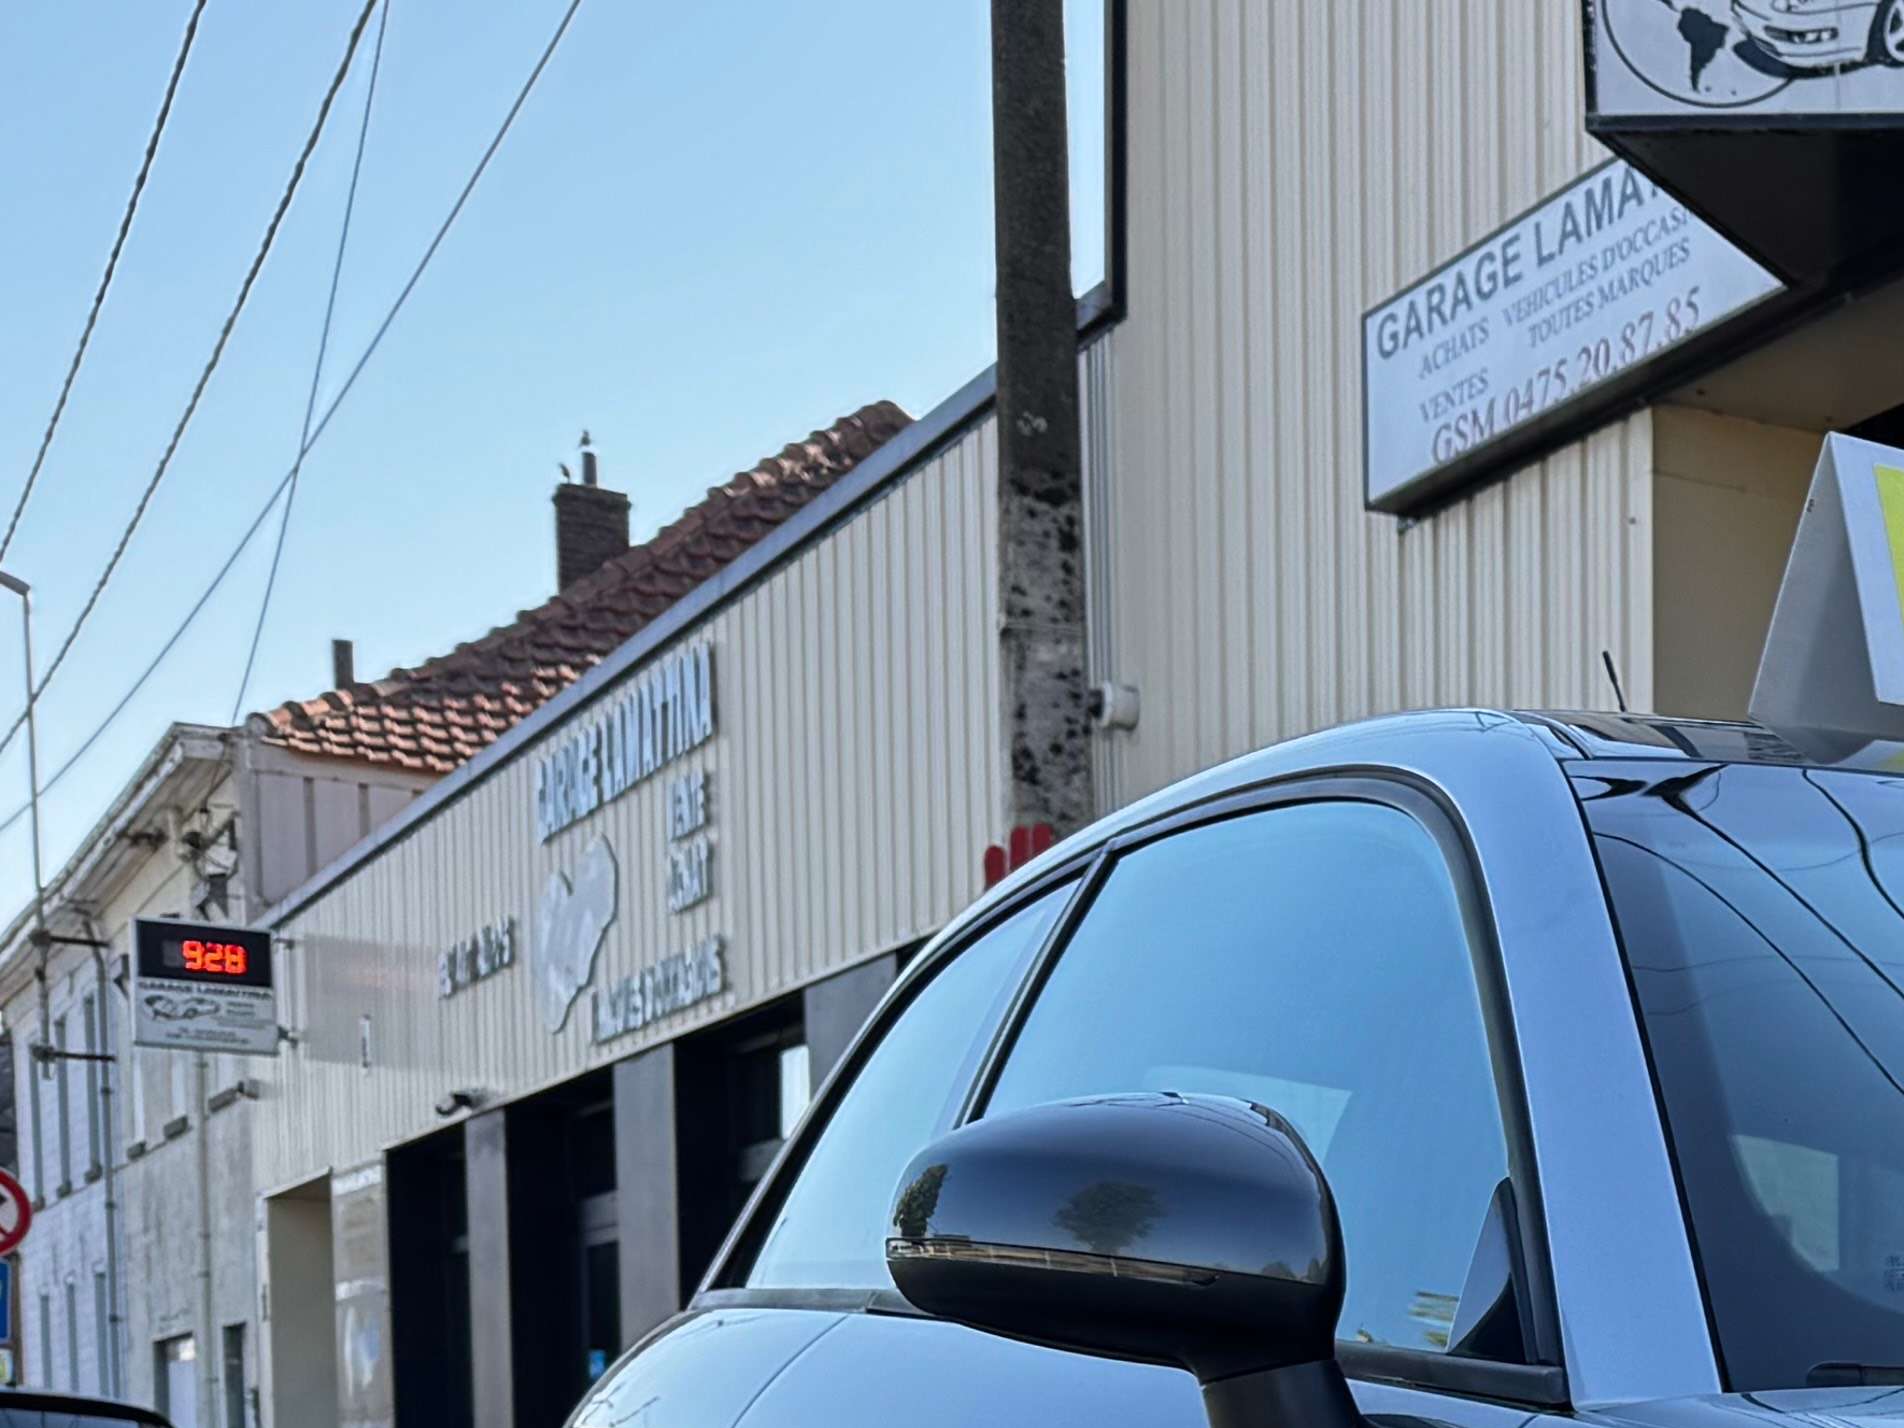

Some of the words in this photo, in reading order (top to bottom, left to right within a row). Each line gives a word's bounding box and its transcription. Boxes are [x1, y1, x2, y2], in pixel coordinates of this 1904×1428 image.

[1376, 234, 1524, 360] GARAGE
[1535, 167, 1659, 268] LAMA
[1500, 254, 1599, 327] VEHICULES
[1527, 294, 1594, 351] TOUTES
[1599, 237, 1691, 310] MARQUES
[1419, 317, 1491, 380] ACHATS
[1418, 368, 1490, 424] VENTES
[1431, 395, 1497, 465] GSM
[182, 940, 248, 974] 928
